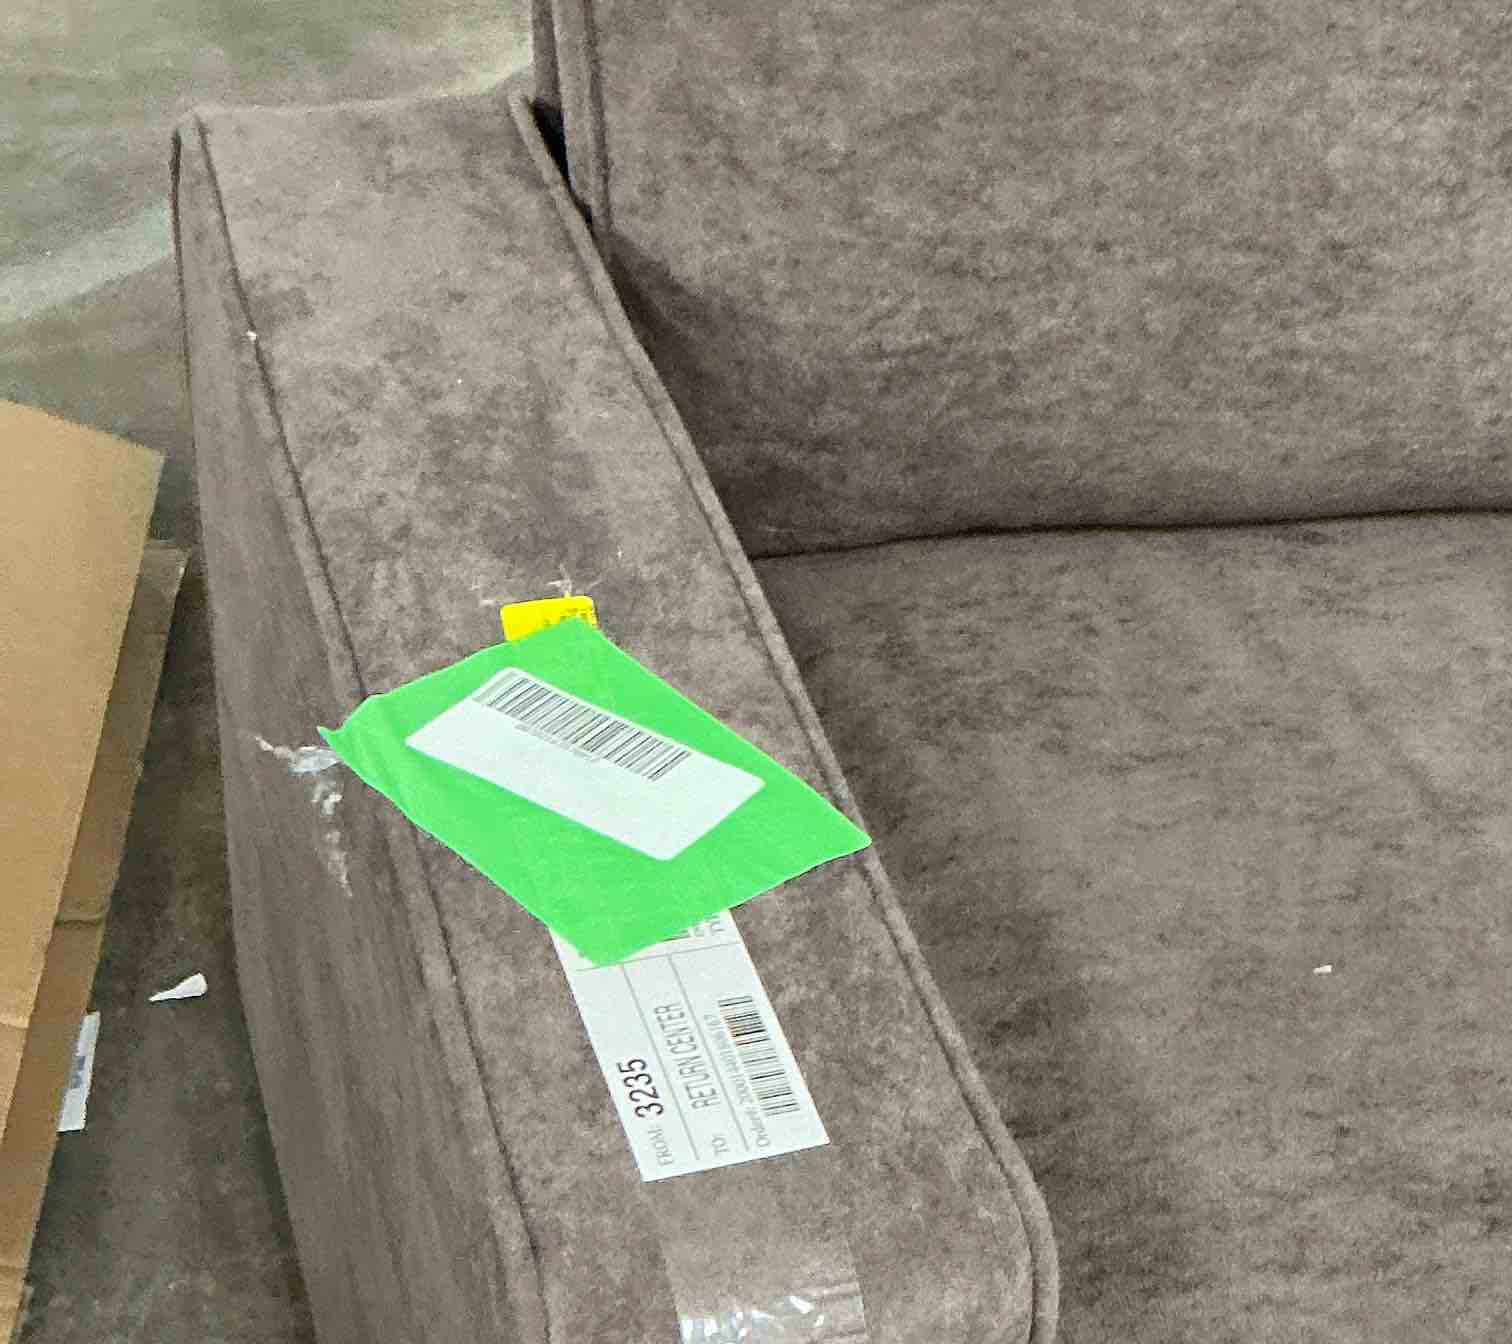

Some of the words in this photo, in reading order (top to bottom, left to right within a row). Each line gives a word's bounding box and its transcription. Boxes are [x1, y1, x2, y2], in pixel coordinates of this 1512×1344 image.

[653, 1003, 698, 1055] CENTER
[616, 1058, 665, 1119] 3235
[676, 1055, 721, 1110] RETURN
